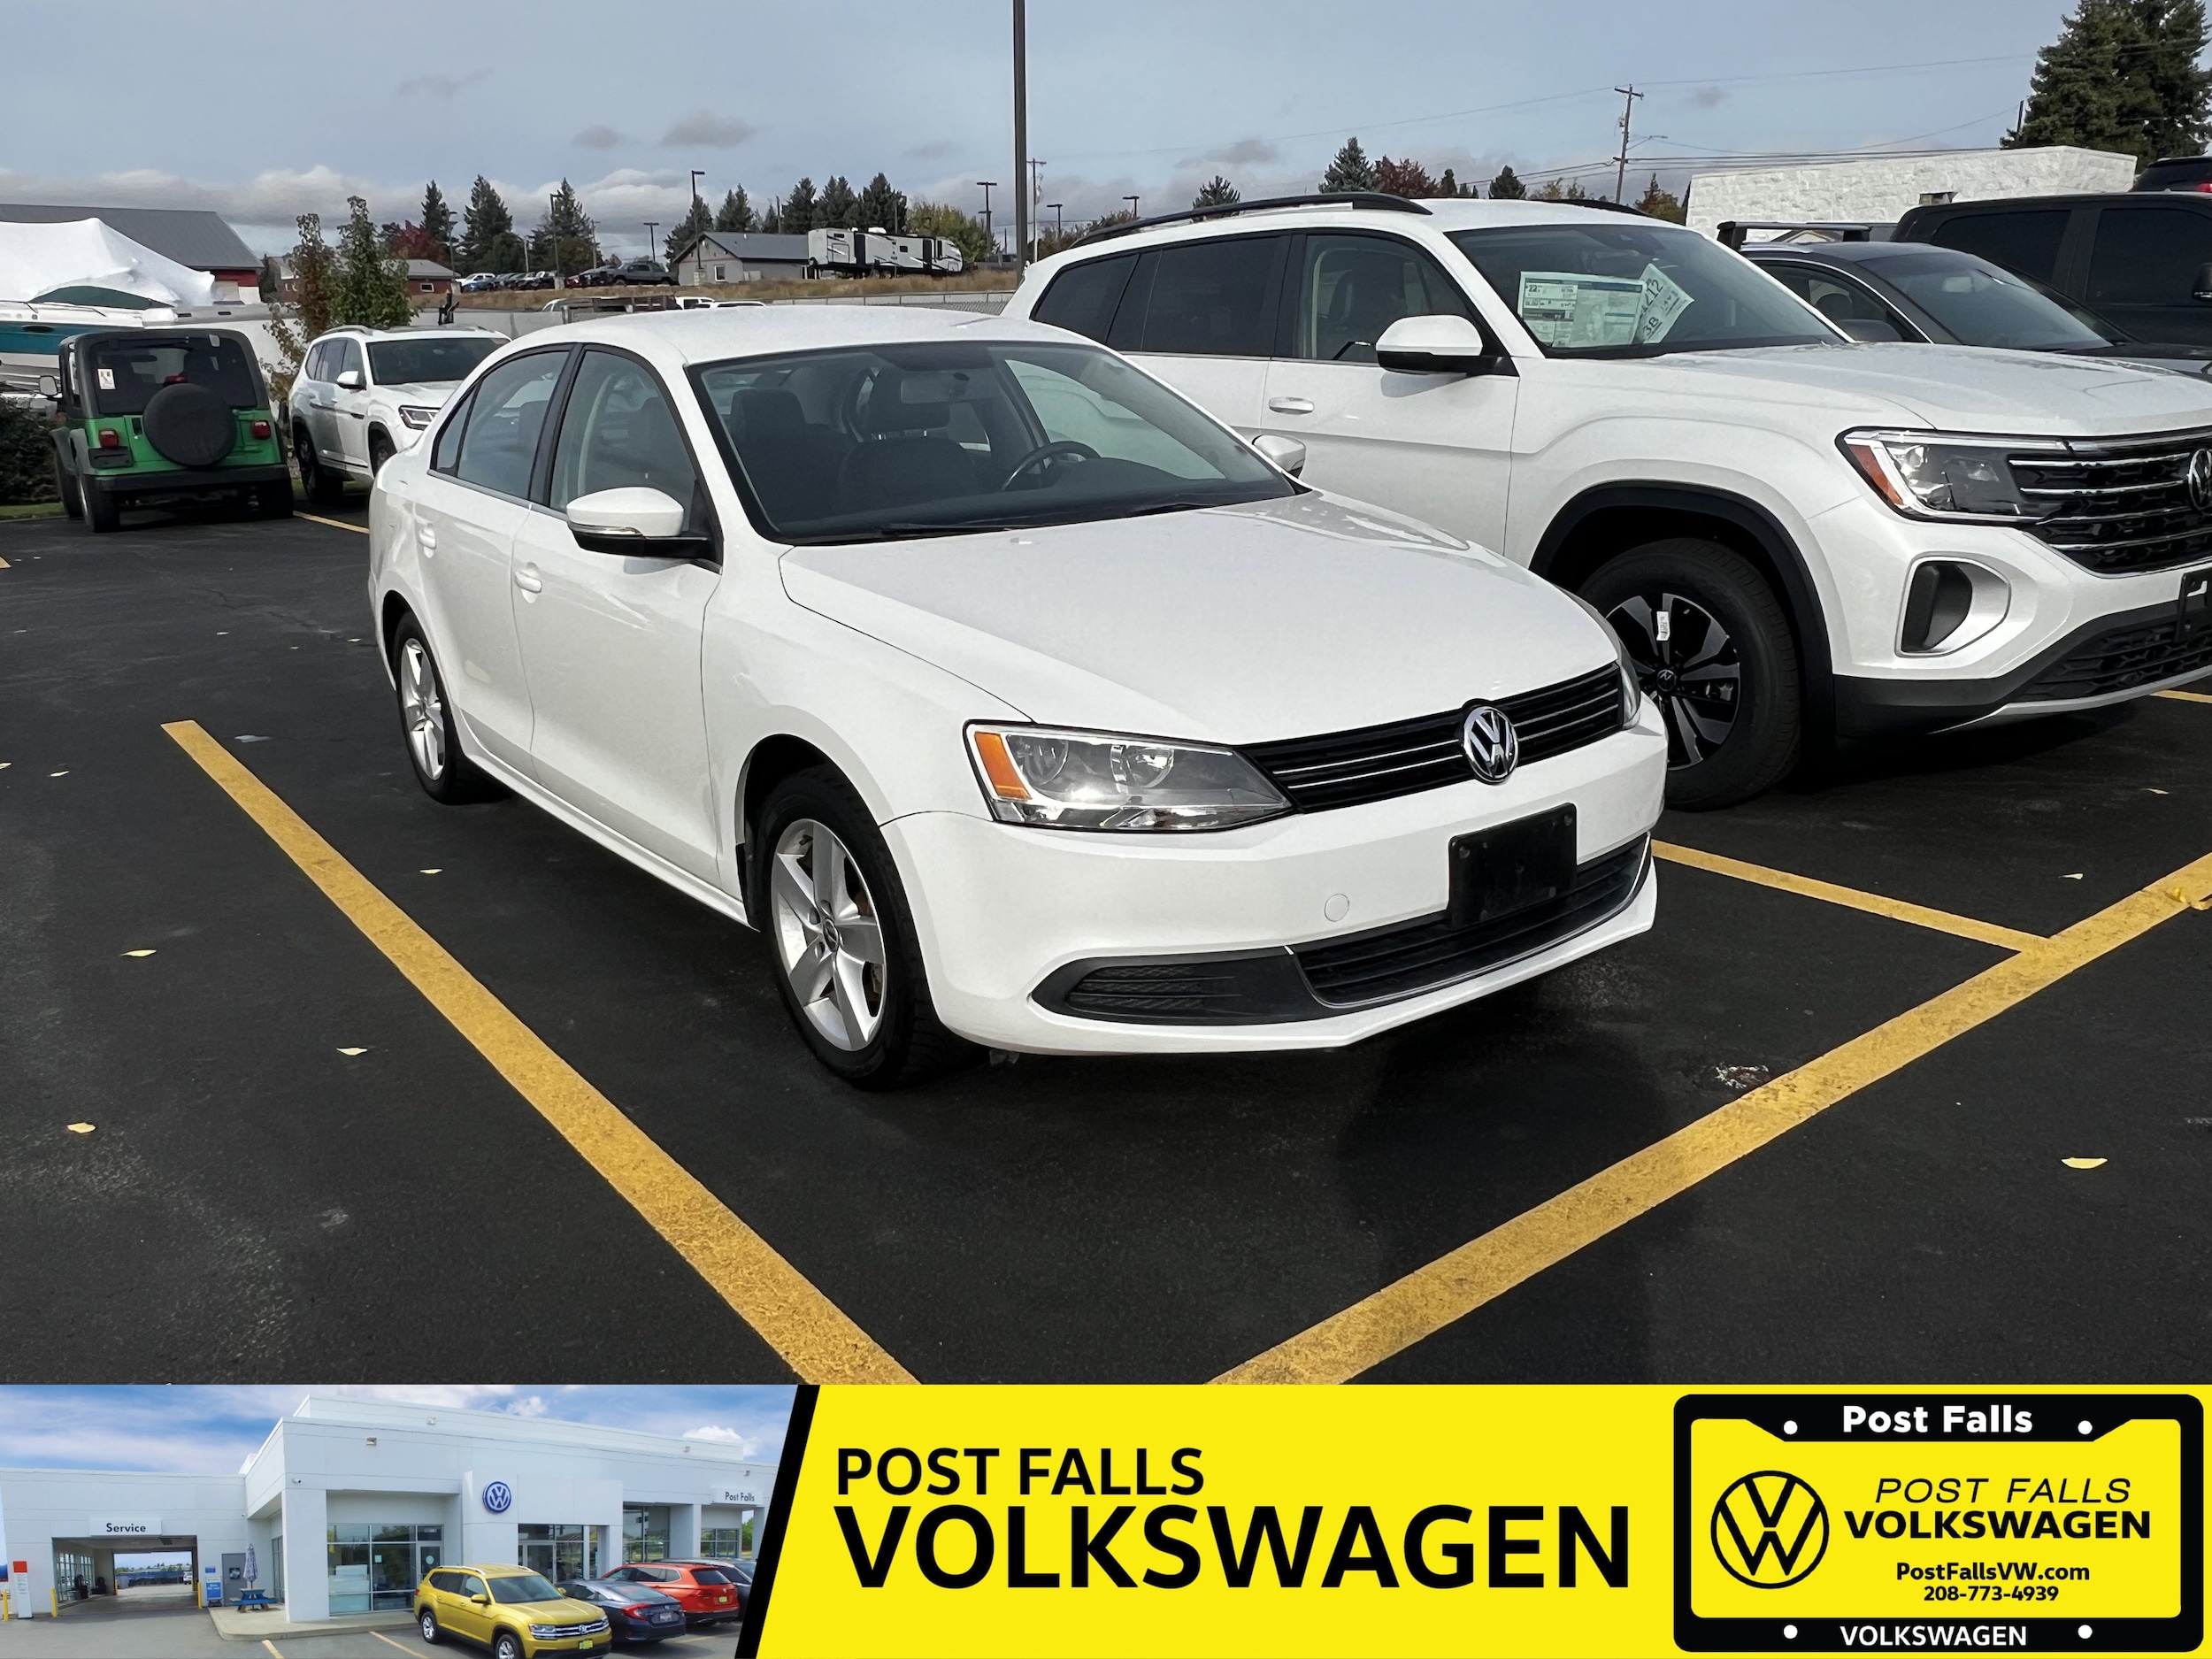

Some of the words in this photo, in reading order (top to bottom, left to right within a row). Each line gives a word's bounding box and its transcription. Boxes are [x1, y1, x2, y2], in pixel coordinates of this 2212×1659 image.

[725, 1491, 739, 1502] Post
[740, 1492, 755, 1502] Falls
[105, 1522, 147, 1533] Service
